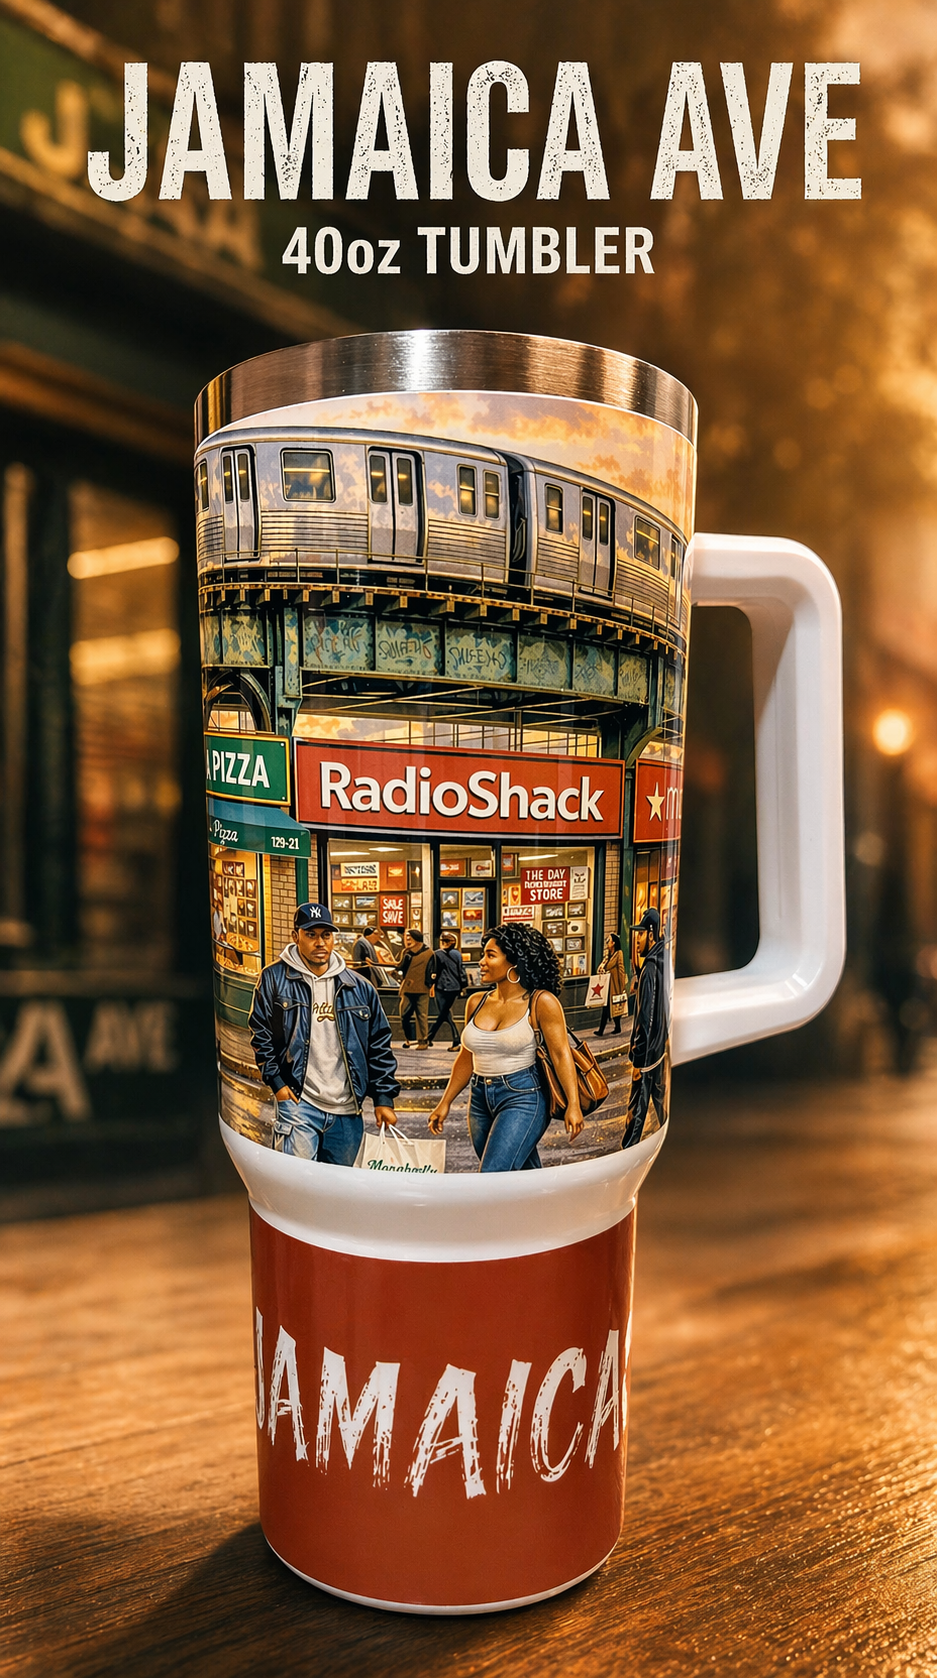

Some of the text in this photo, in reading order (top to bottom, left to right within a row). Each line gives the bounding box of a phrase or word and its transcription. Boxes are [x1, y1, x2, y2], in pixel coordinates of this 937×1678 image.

[212, 749, 270, 789] PIZZA
[319, 760, 605, 823] RadioShack
[270, 836, 300, 850] 129-21
[525, 868, 566, 881] THE DAY
[529, 888, 564, 902] STORE
[254, 1306, 621, 1500] JAMAICA
